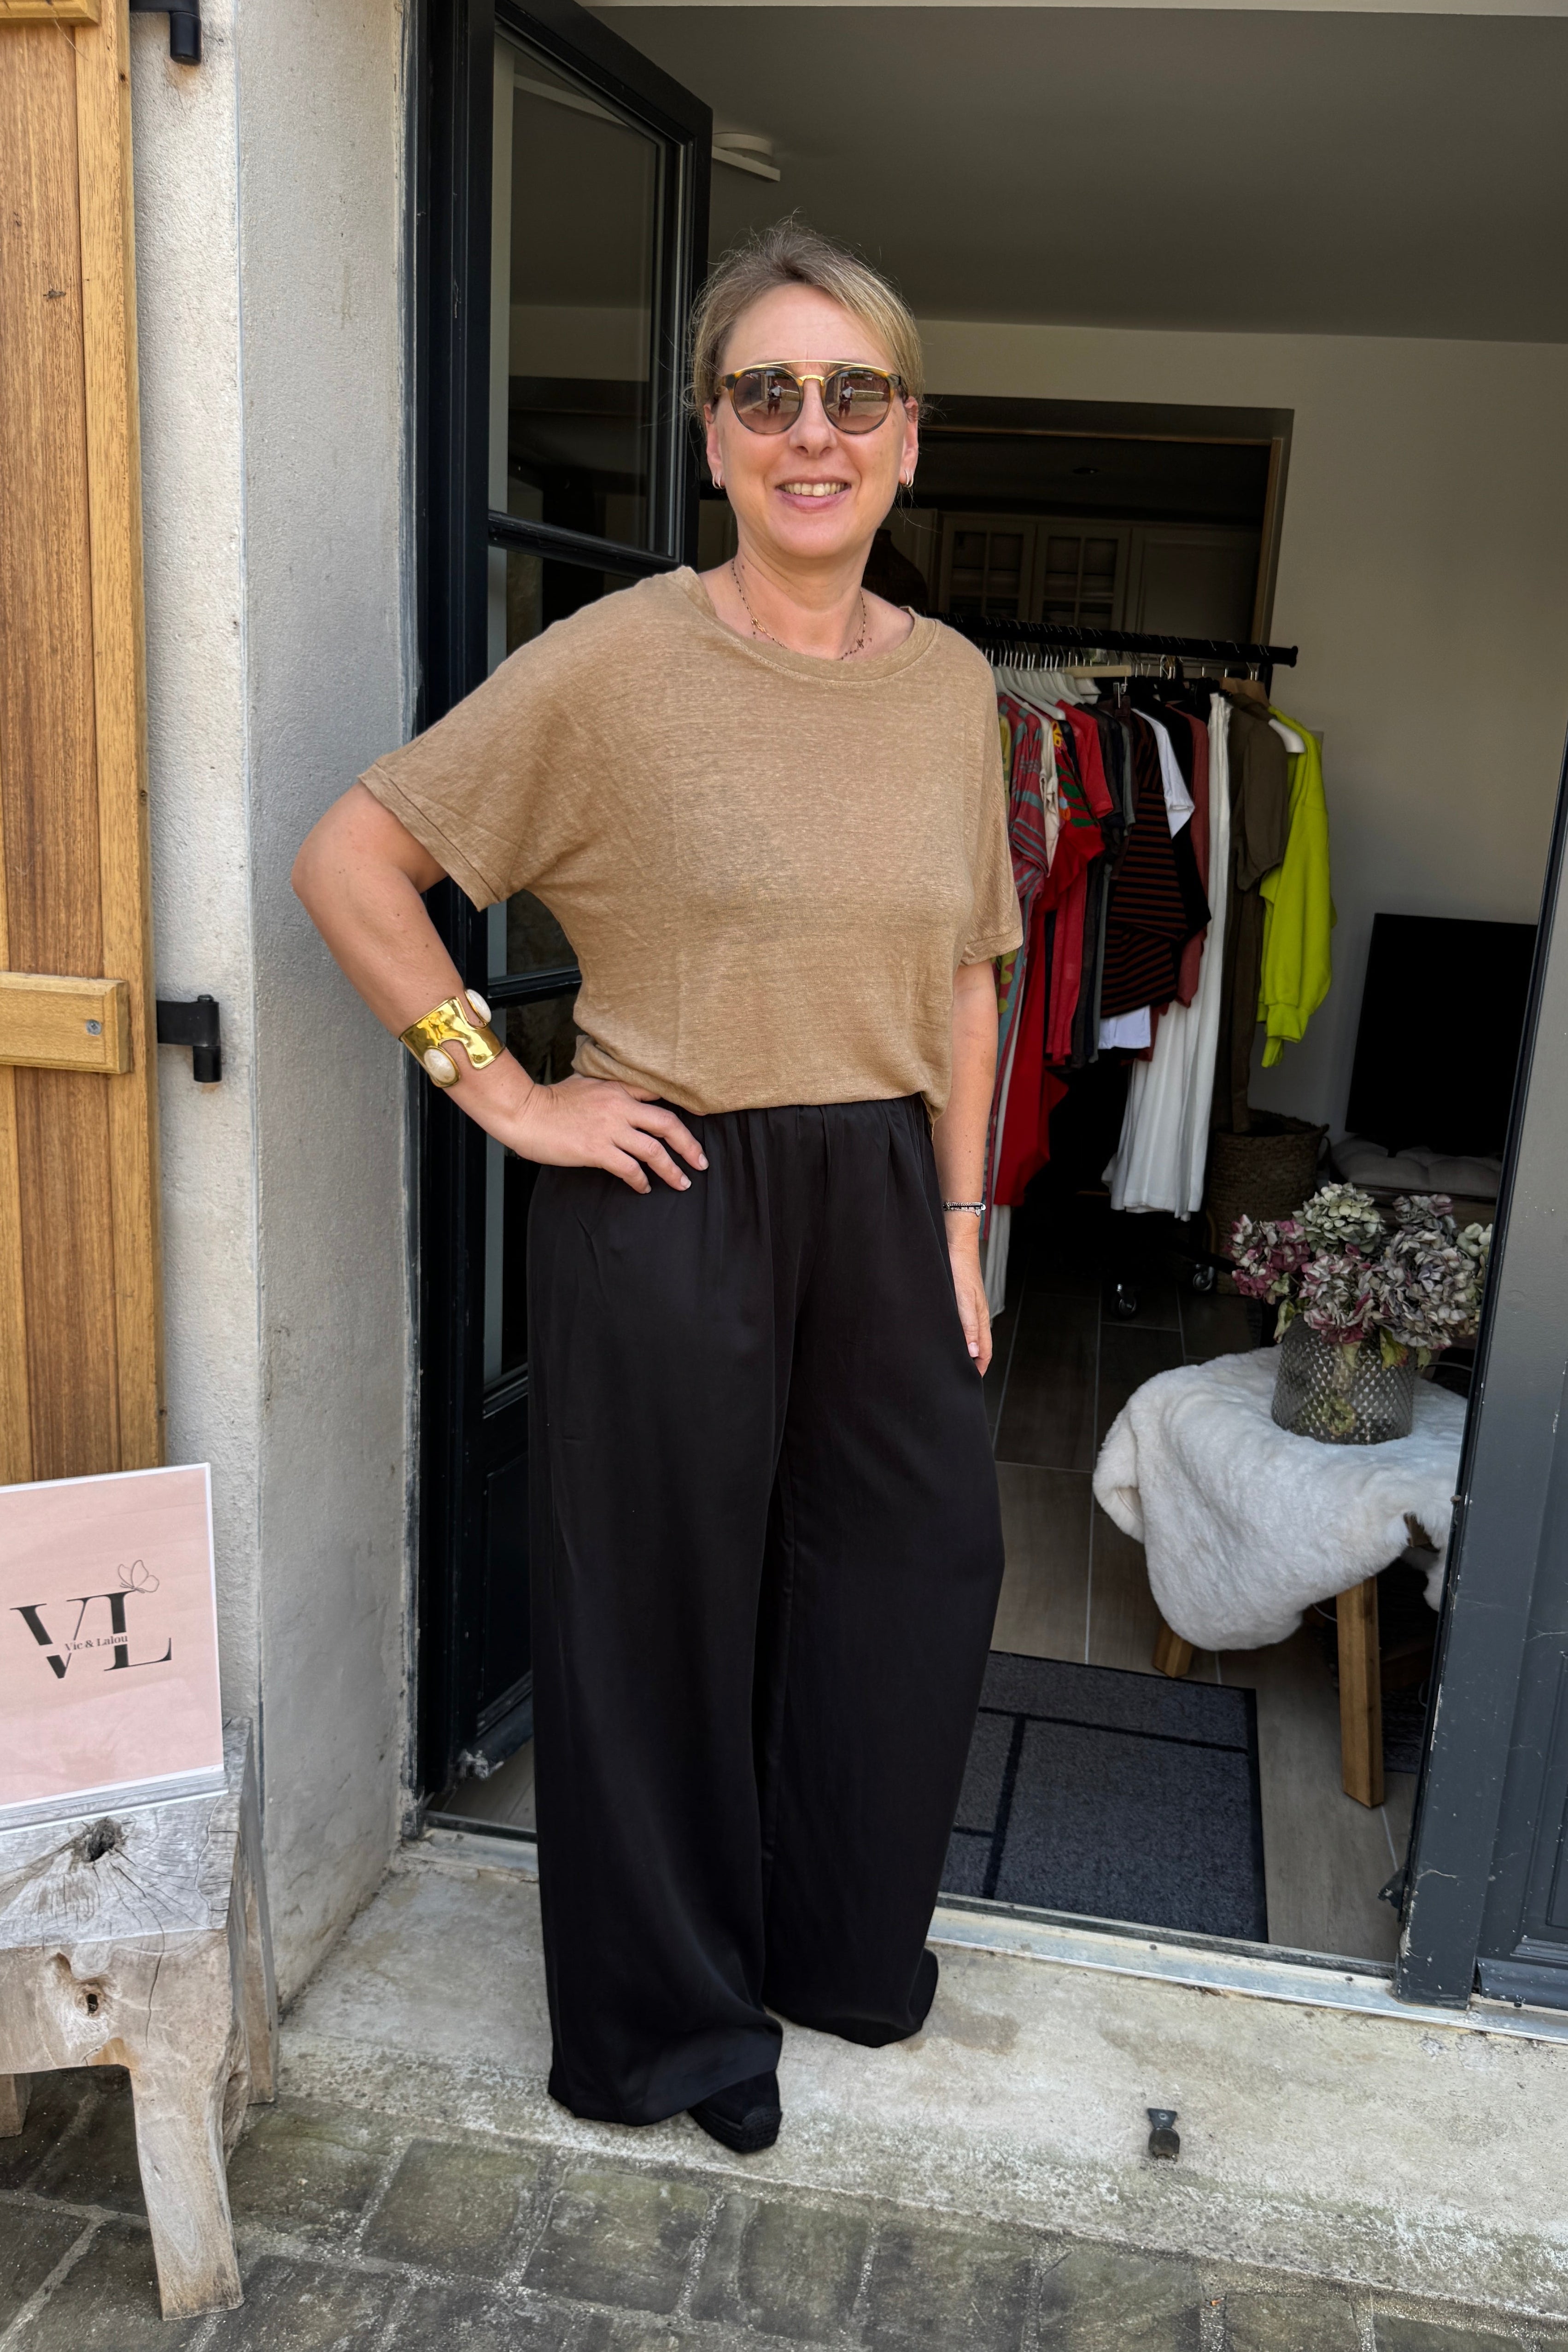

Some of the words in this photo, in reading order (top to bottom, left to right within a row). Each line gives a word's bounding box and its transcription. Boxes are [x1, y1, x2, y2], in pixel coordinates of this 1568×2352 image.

[10, 1589, 172, 1679] VL
[64, 1641, 83, 1651] Vic
[85, 1640, 94, 1648] &
[97, 1635, 128, 1647] Lalou
